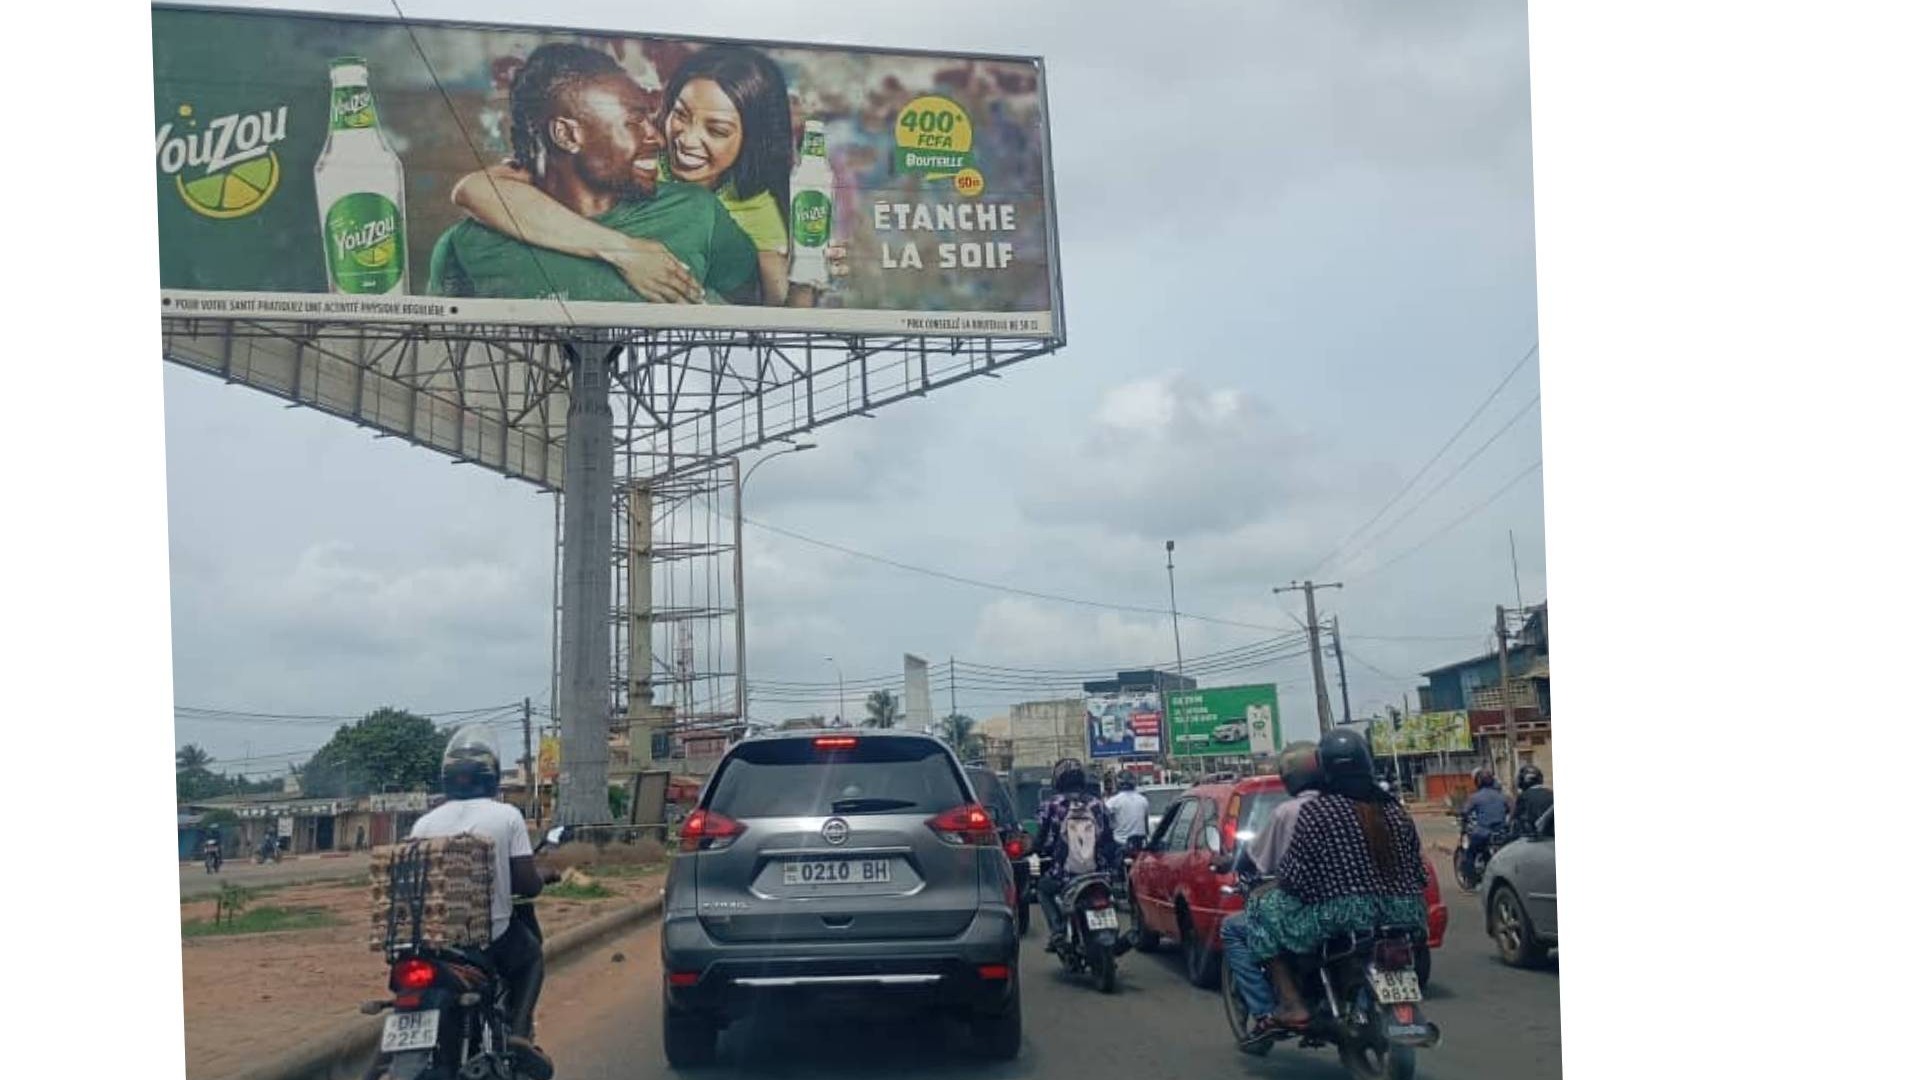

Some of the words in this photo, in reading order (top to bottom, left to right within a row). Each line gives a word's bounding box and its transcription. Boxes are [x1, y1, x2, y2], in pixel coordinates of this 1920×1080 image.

[918, 134, 953, 148] FCFA
[874, 200, 1016, 231] ÉTANCHE
[881, 243, 923, 269] LA
[939, 242, 1014, 269] SOIF
[802, 862, 849, 881] 0210
[862, 863, 887, 879] BH
